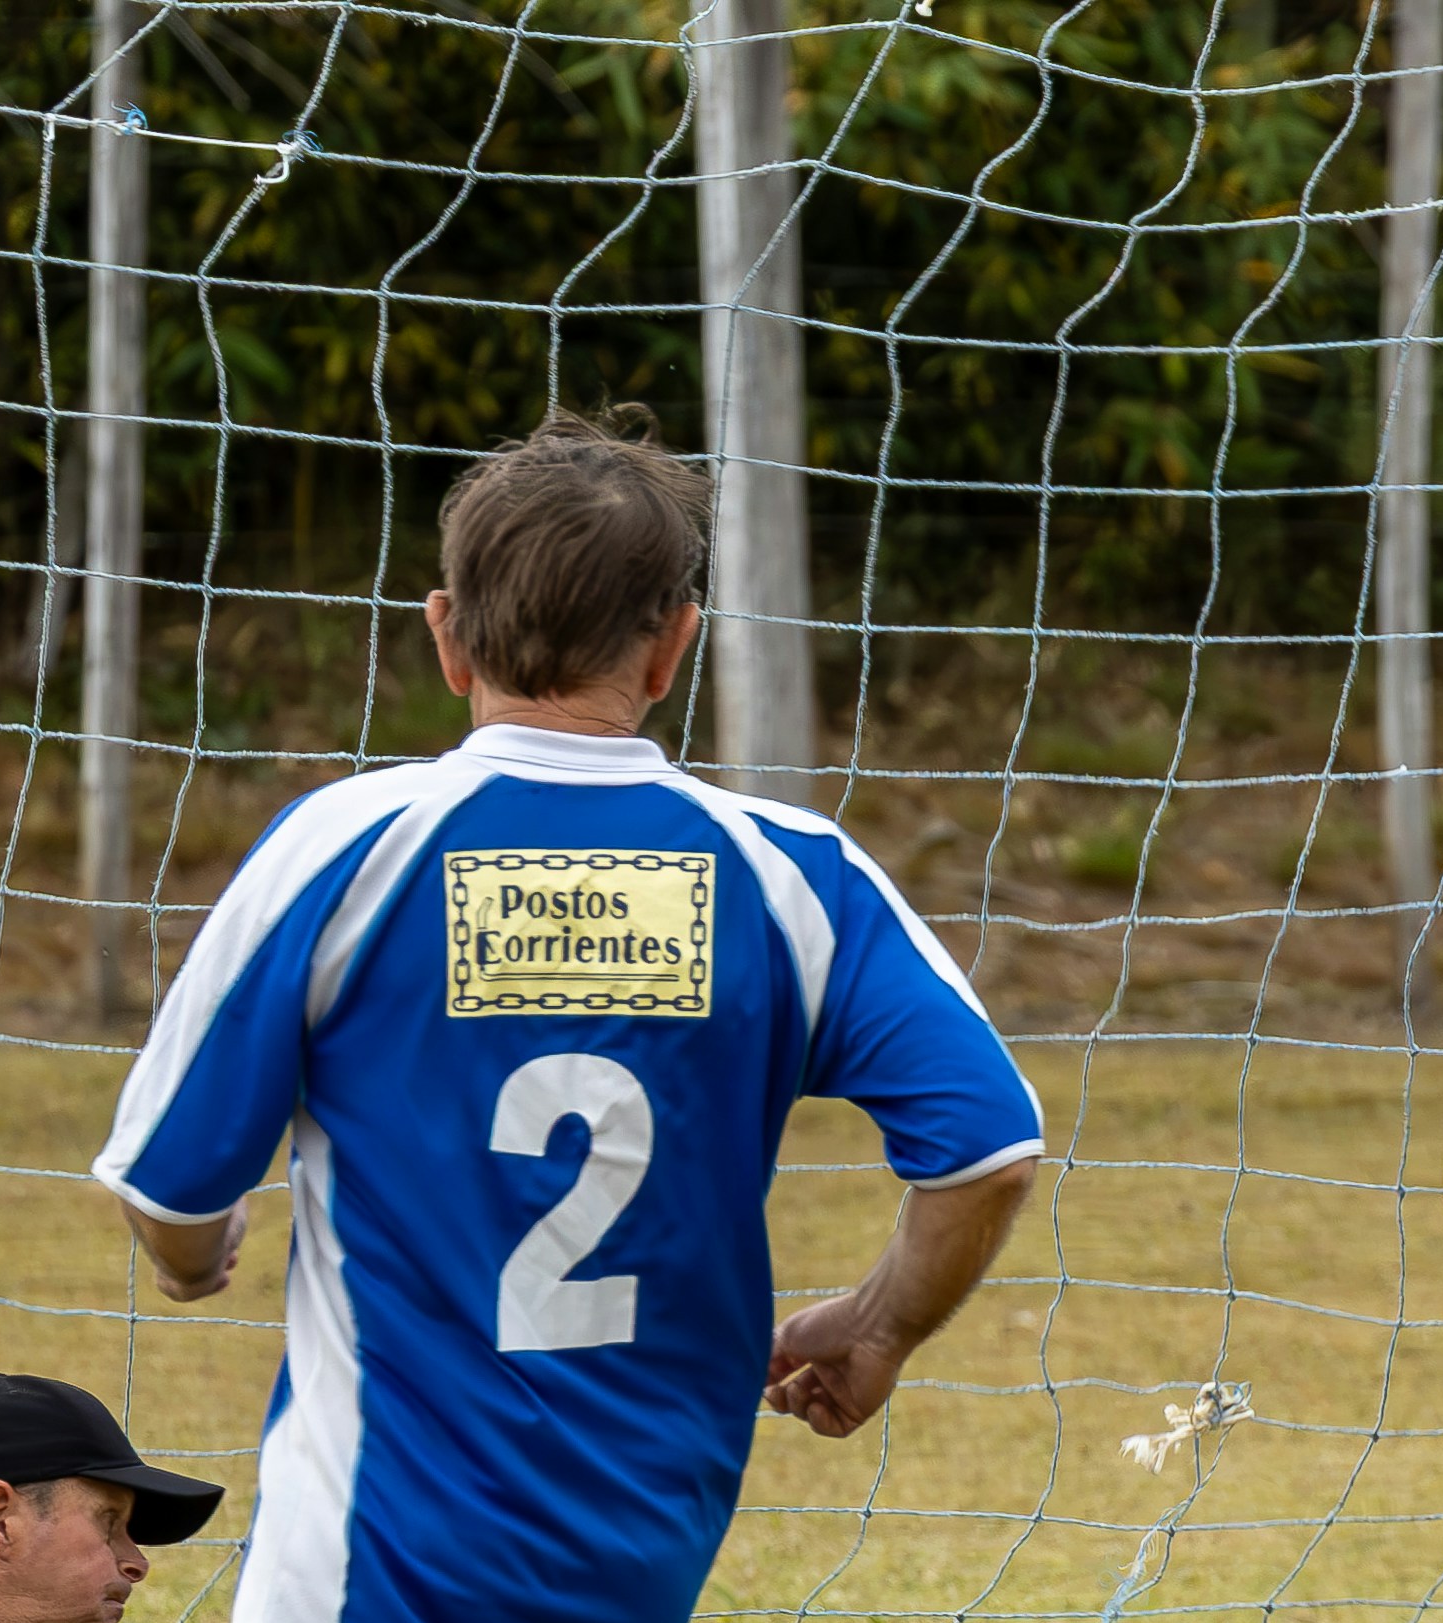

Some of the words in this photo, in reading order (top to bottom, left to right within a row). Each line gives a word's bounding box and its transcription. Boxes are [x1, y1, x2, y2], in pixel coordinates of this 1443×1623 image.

[499, 884, 629, 920] Postos
[476, 925, 682, 966] Corrientes
[489, 1052, 654, 1352] 2
